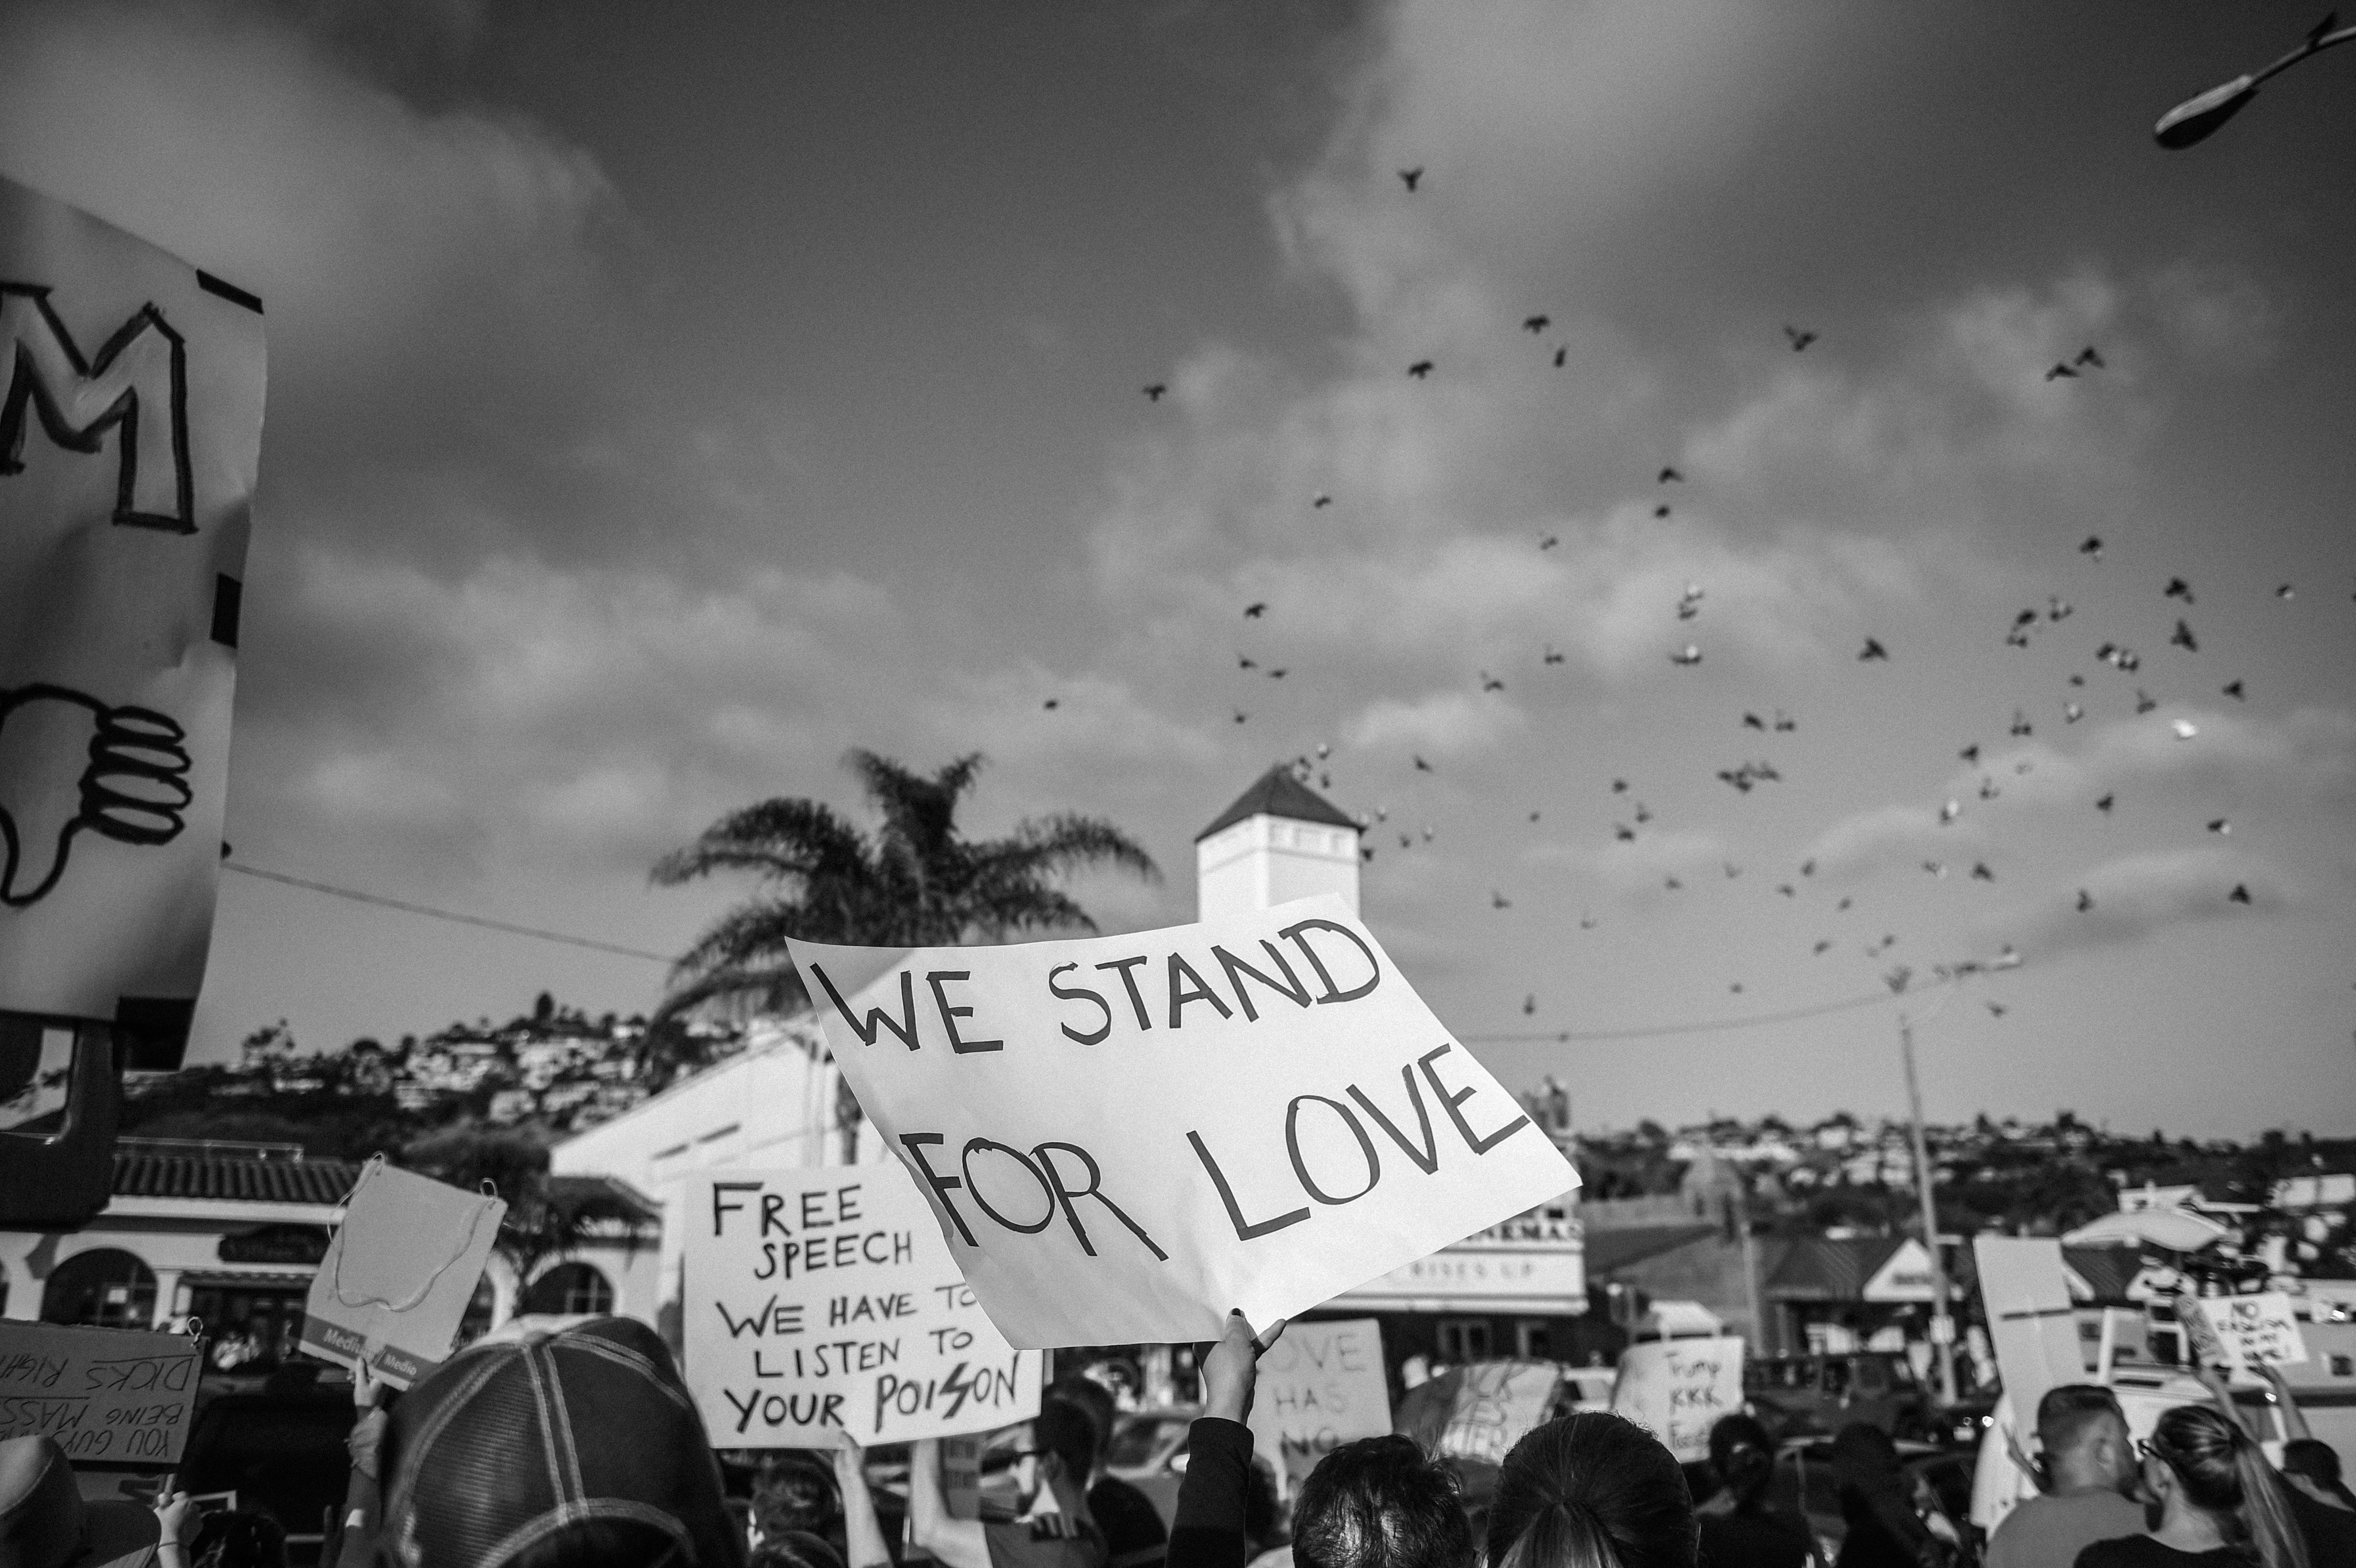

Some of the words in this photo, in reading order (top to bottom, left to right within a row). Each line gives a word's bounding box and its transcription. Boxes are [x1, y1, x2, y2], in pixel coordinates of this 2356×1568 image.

[0, 280, 199, 534] M
[810, 961, 1003, 1055] WE
[1048, 918, 1381, 1046] STAND
[899, 1132, 1169, 1262] FOR
[1186, 1043, 1531, 1241] LOVE
[713, 1182, 862, 1238] FREE
[754, 1231, 912, 1280] SPEECH
[715, 1294, 805, 1339] WE
[829, 1292, 918, 1328] HAVE
[935, 1282, 978, 1311] TO
[383, 1353, 417, 1376] Medio
[754, 1338, 901, 1379] LISTEN
[929, 1328, 974, 1354] TO
[1255, 1332, 1366, 1373] OVE
[86, 1358, 194, 1392] DICKS
[724, 1388, 846, 1434] YOUR
[874, 1350, 1020, 1434] POISON
[0, 1398, 89, 1430] MASS
[106, 1403, 185, 1426] BEING
[1272, 1383, 1347, 1416] HAS
[1669, 1387, 1724, 1413] KKK
[127, 1428, 168, 1457] YOU
[1279, 1425, 1340, 1459] NO
